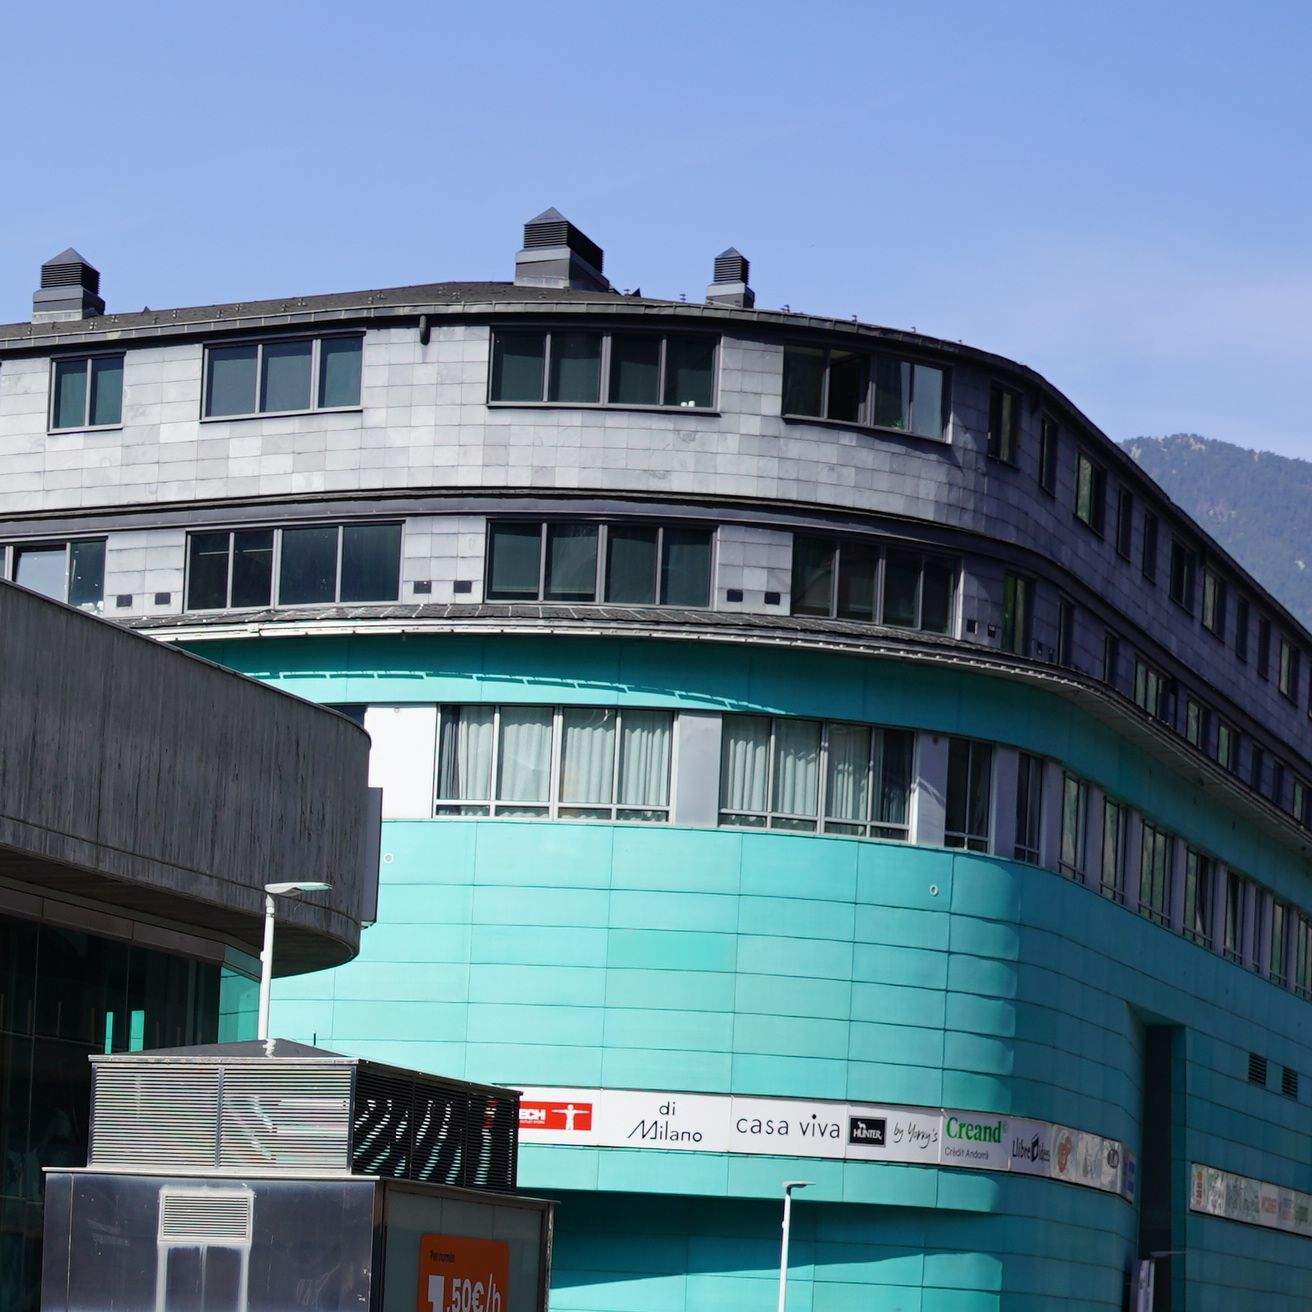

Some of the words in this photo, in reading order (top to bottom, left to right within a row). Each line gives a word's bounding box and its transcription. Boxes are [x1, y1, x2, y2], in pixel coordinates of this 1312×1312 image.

[659, 1101, 676, 1116] di
[628, 1119, 703, 1143] Milano
[736, 1117, 789, 1136] casa
[799, 1113, 840, 1139] viva
[853, 1127, 883, 1140] HUNTER
[892, 1122, 904, 1143] by
[946, 1116, 1003, 1144] Creand
